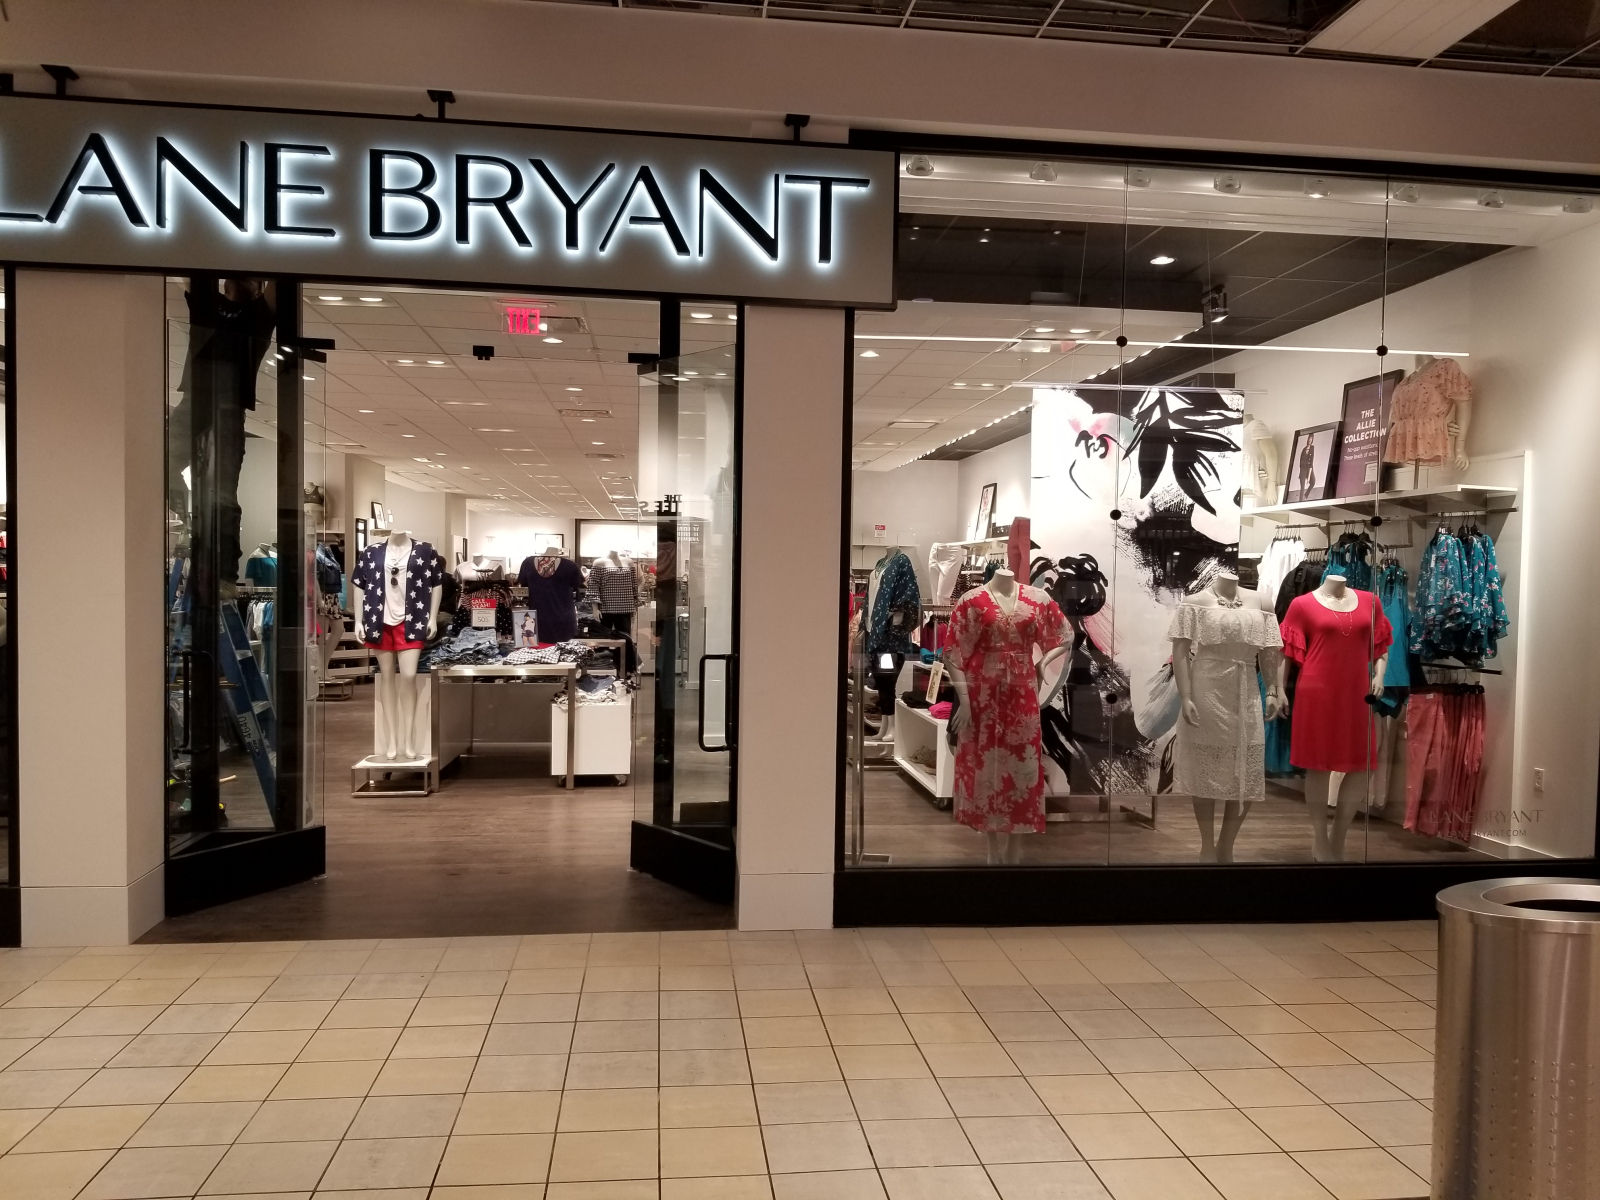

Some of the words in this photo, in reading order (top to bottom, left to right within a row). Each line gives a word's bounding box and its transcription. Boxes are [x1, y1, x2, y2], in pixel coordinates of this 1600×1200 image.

[369, 148, 870, 264] BRYANT
[1361, 408, 1374, 418] THE
[1356, 419, 1376, 431] ALLIE
[1429, 810, 1474, 824] LANE
[1447, 829, 1527, 838] LANERYANT.COM
